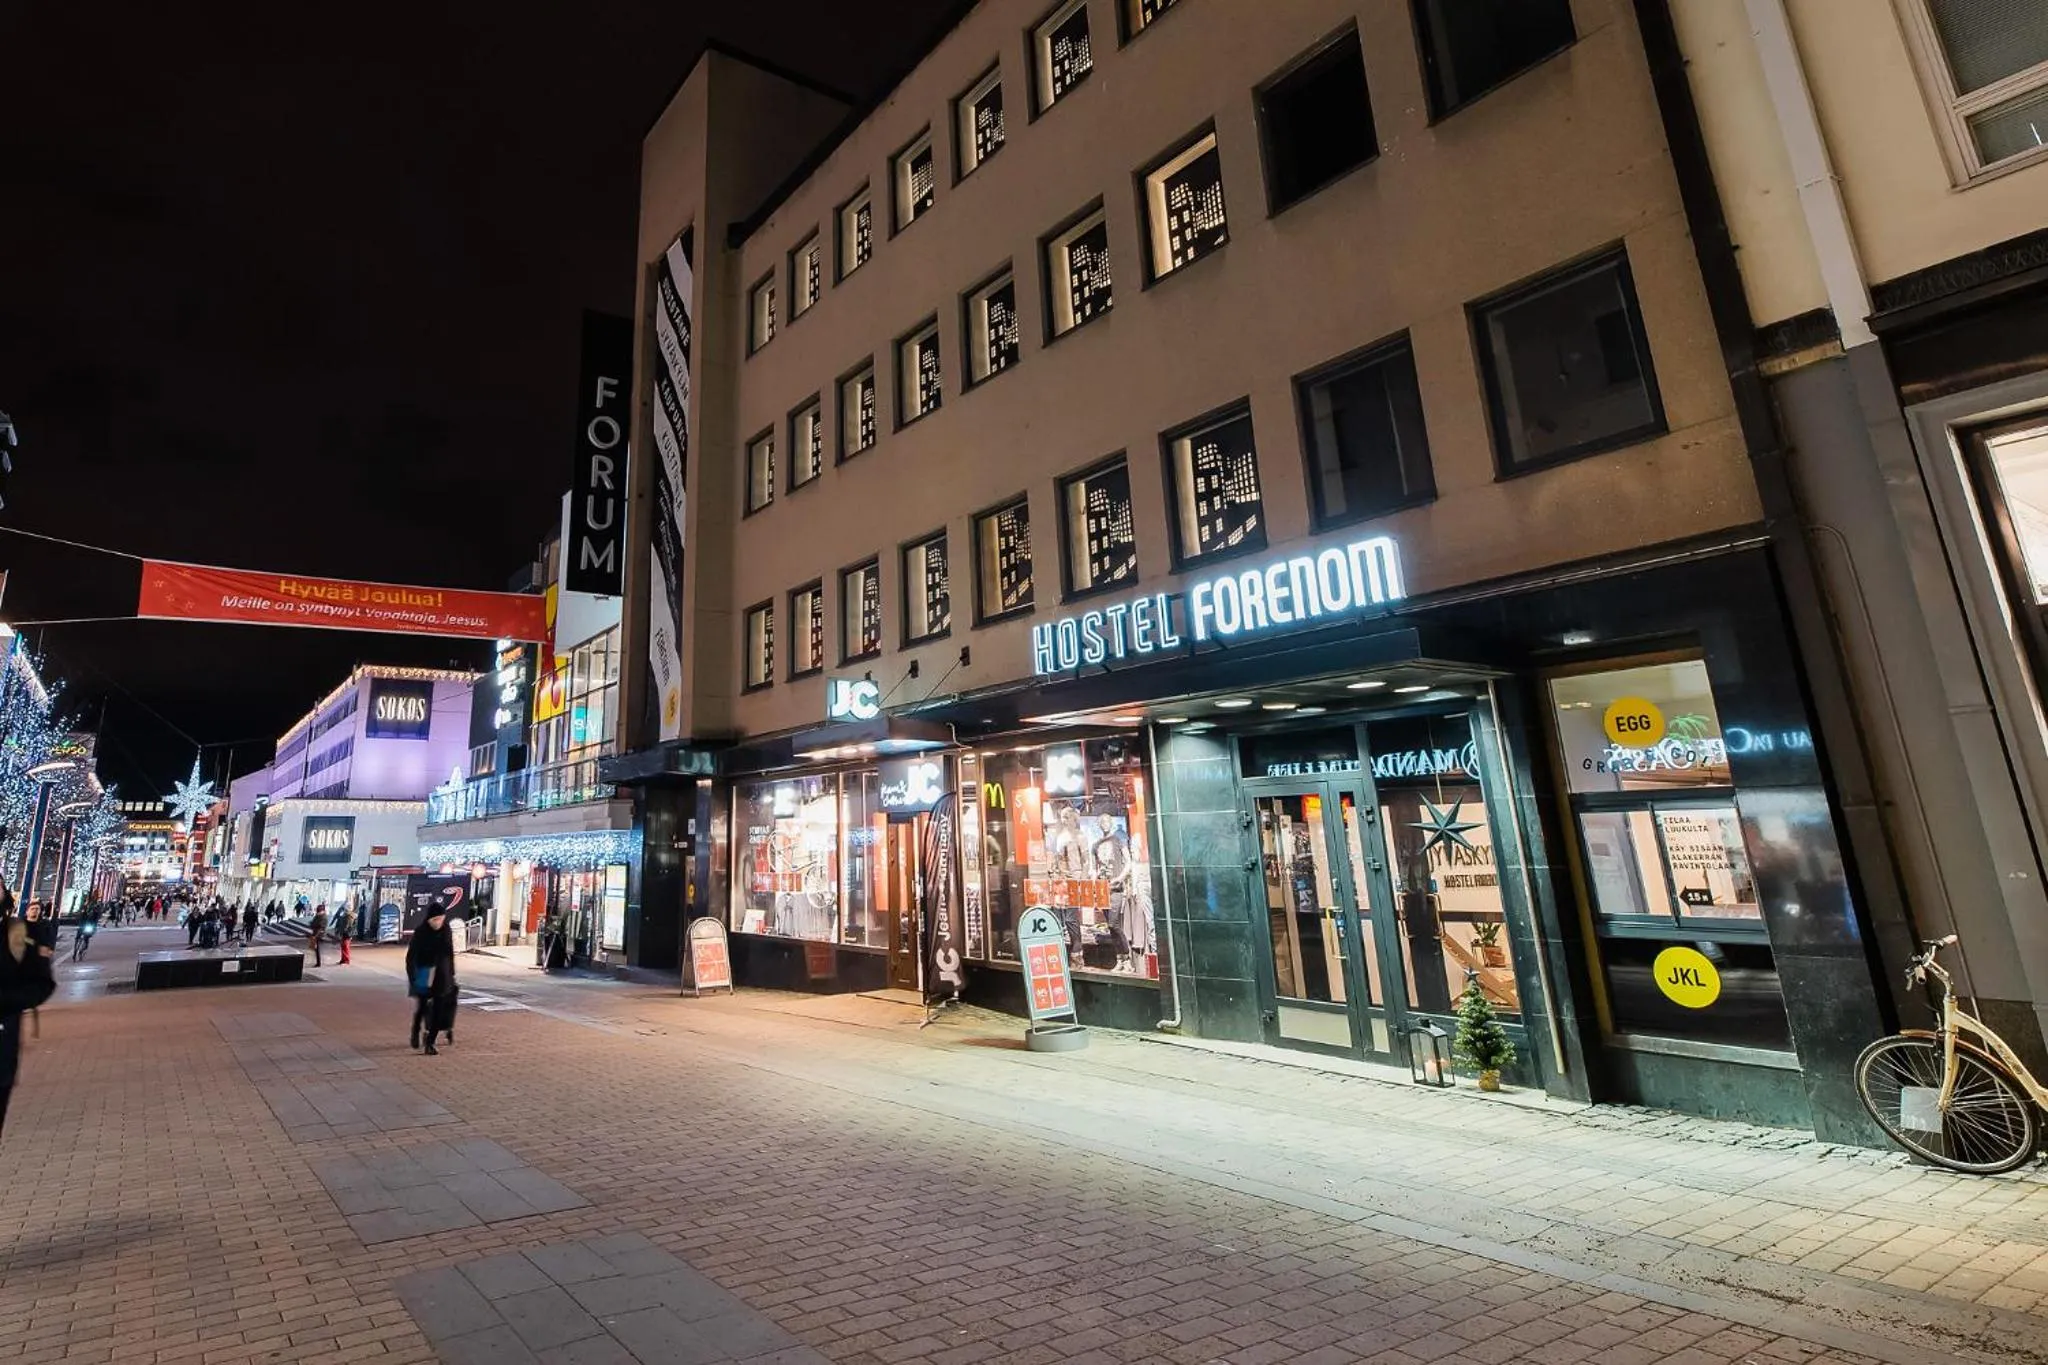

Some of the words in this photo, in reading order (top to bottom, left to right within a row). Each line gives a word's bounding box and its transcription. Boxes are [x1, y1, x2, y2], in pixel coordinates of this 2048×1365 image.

[580, 375, 620, 573] FORUM
[221, 595, 271, 610] Meille
[275, 601, 294, 612] on
[279, 579, 354, 600] Hyvää
[359, 586, 443, 607] Joulua!
[1032, 593, 1180, 676] HOSTEL
[1191, 535, 1408, 641] FORENOM
[376, 695, 426, 722] SOKOS
[832, 679, 880, 720] JC
[1615, 714, 1652, 732] EGG
[904, 762, 941, 804] JC
[1044, 754, 1083, 796] JC
[308, 829, 350, 849] SOKOS
[1031, 917, 1048, 934] JC
[936, 946, 962, 986] JC
[1667, 967, 1707, 987] JKL
